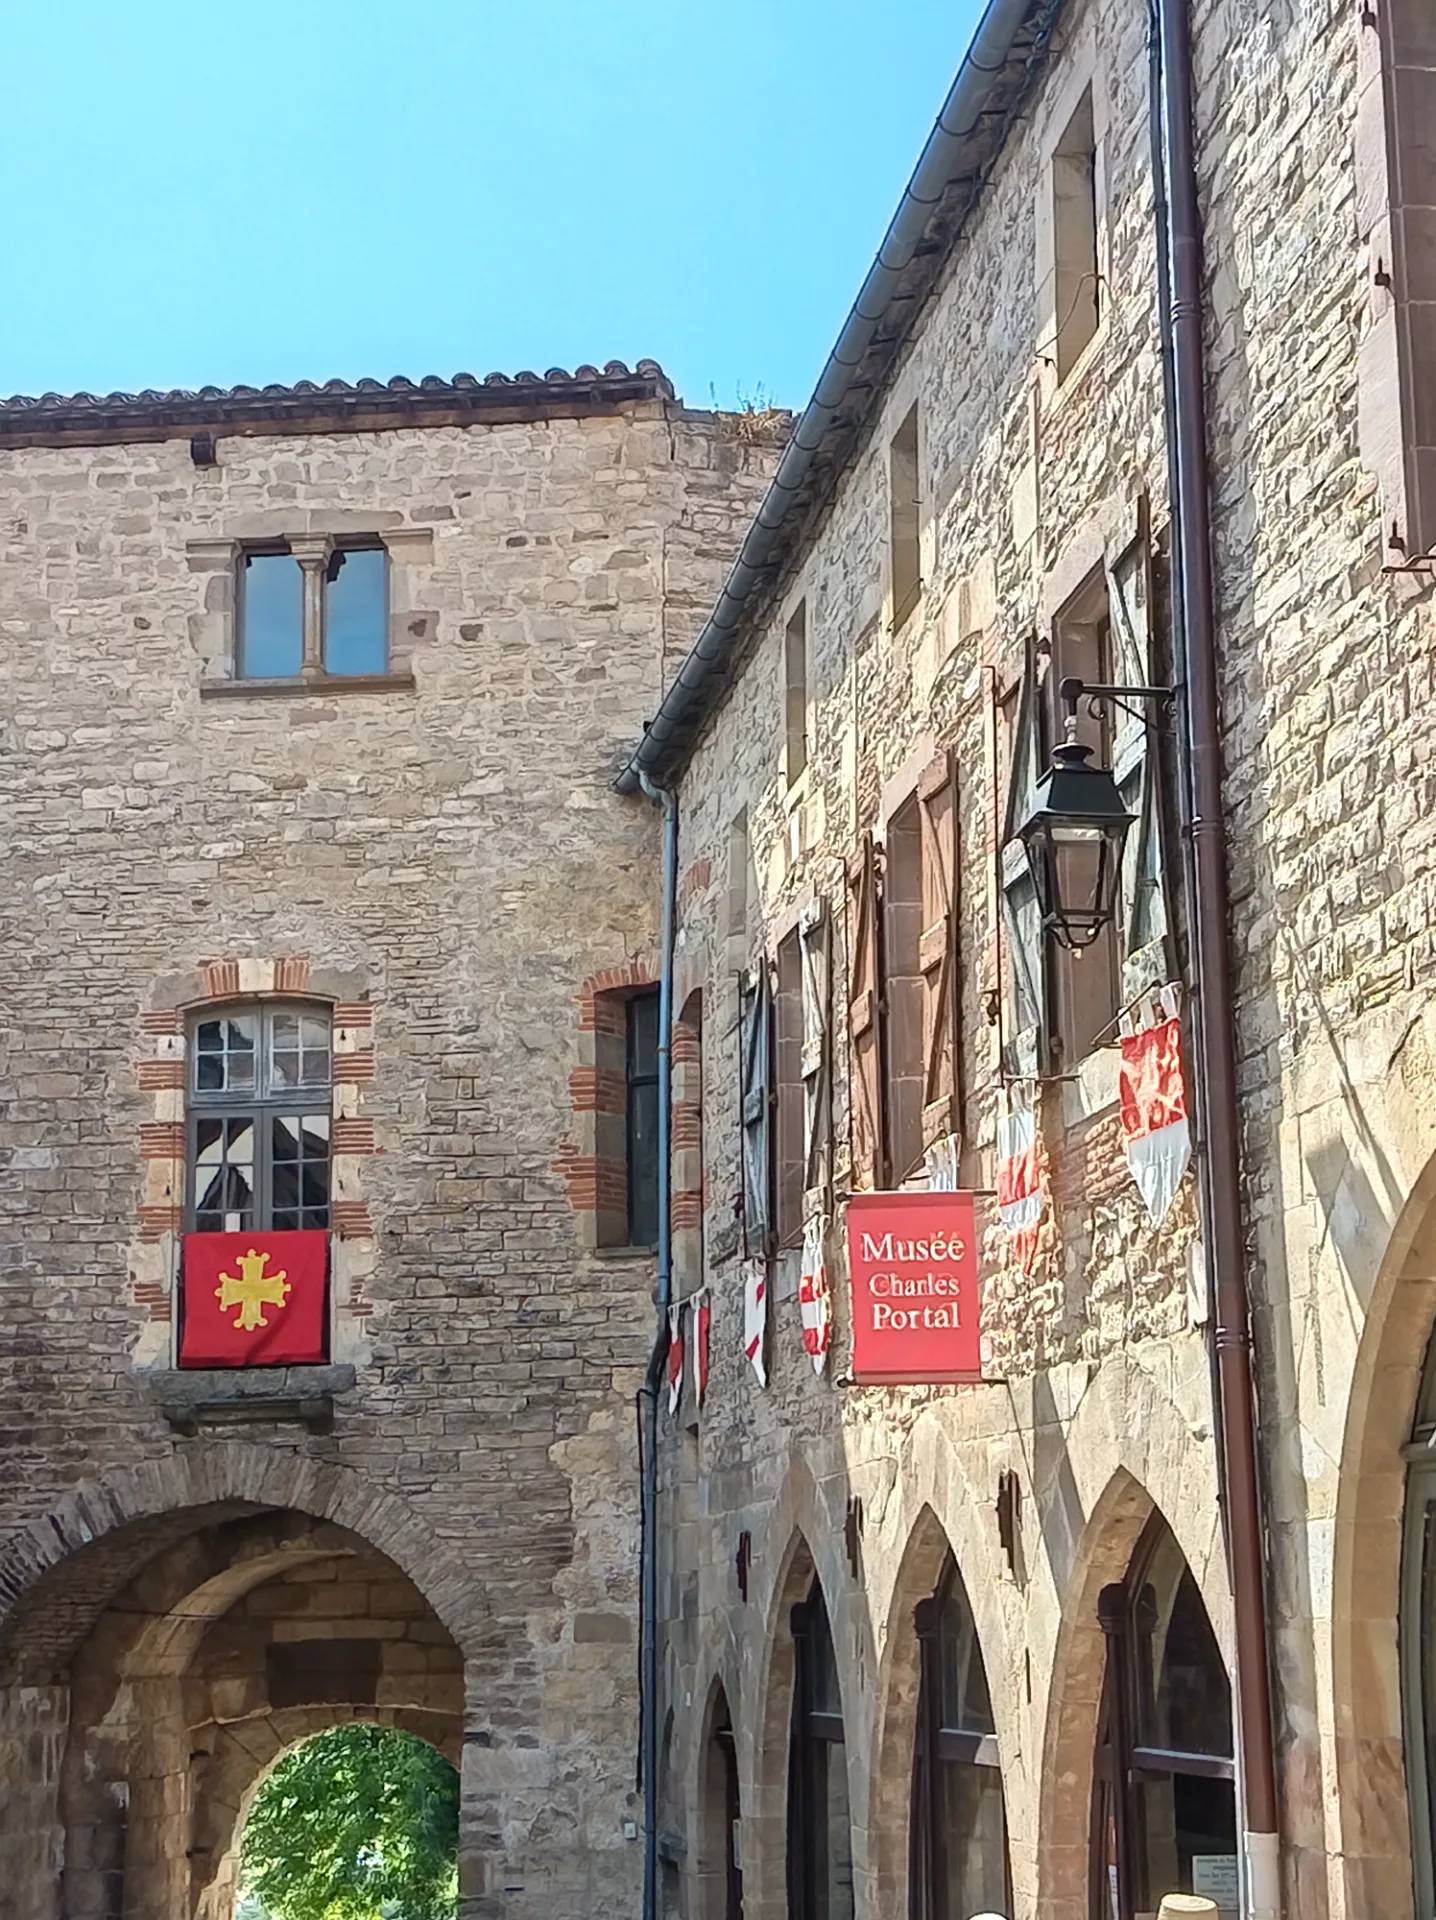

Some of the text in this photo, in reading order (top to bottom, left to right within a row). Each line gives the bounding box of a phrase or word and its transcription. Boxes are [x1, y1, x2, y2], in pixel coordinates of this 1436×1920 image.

[861, 1231, 965, 1261] Musée
[869, 1272, 960, 1297] Charles
[873, 1302, 960, 1330] Portal
